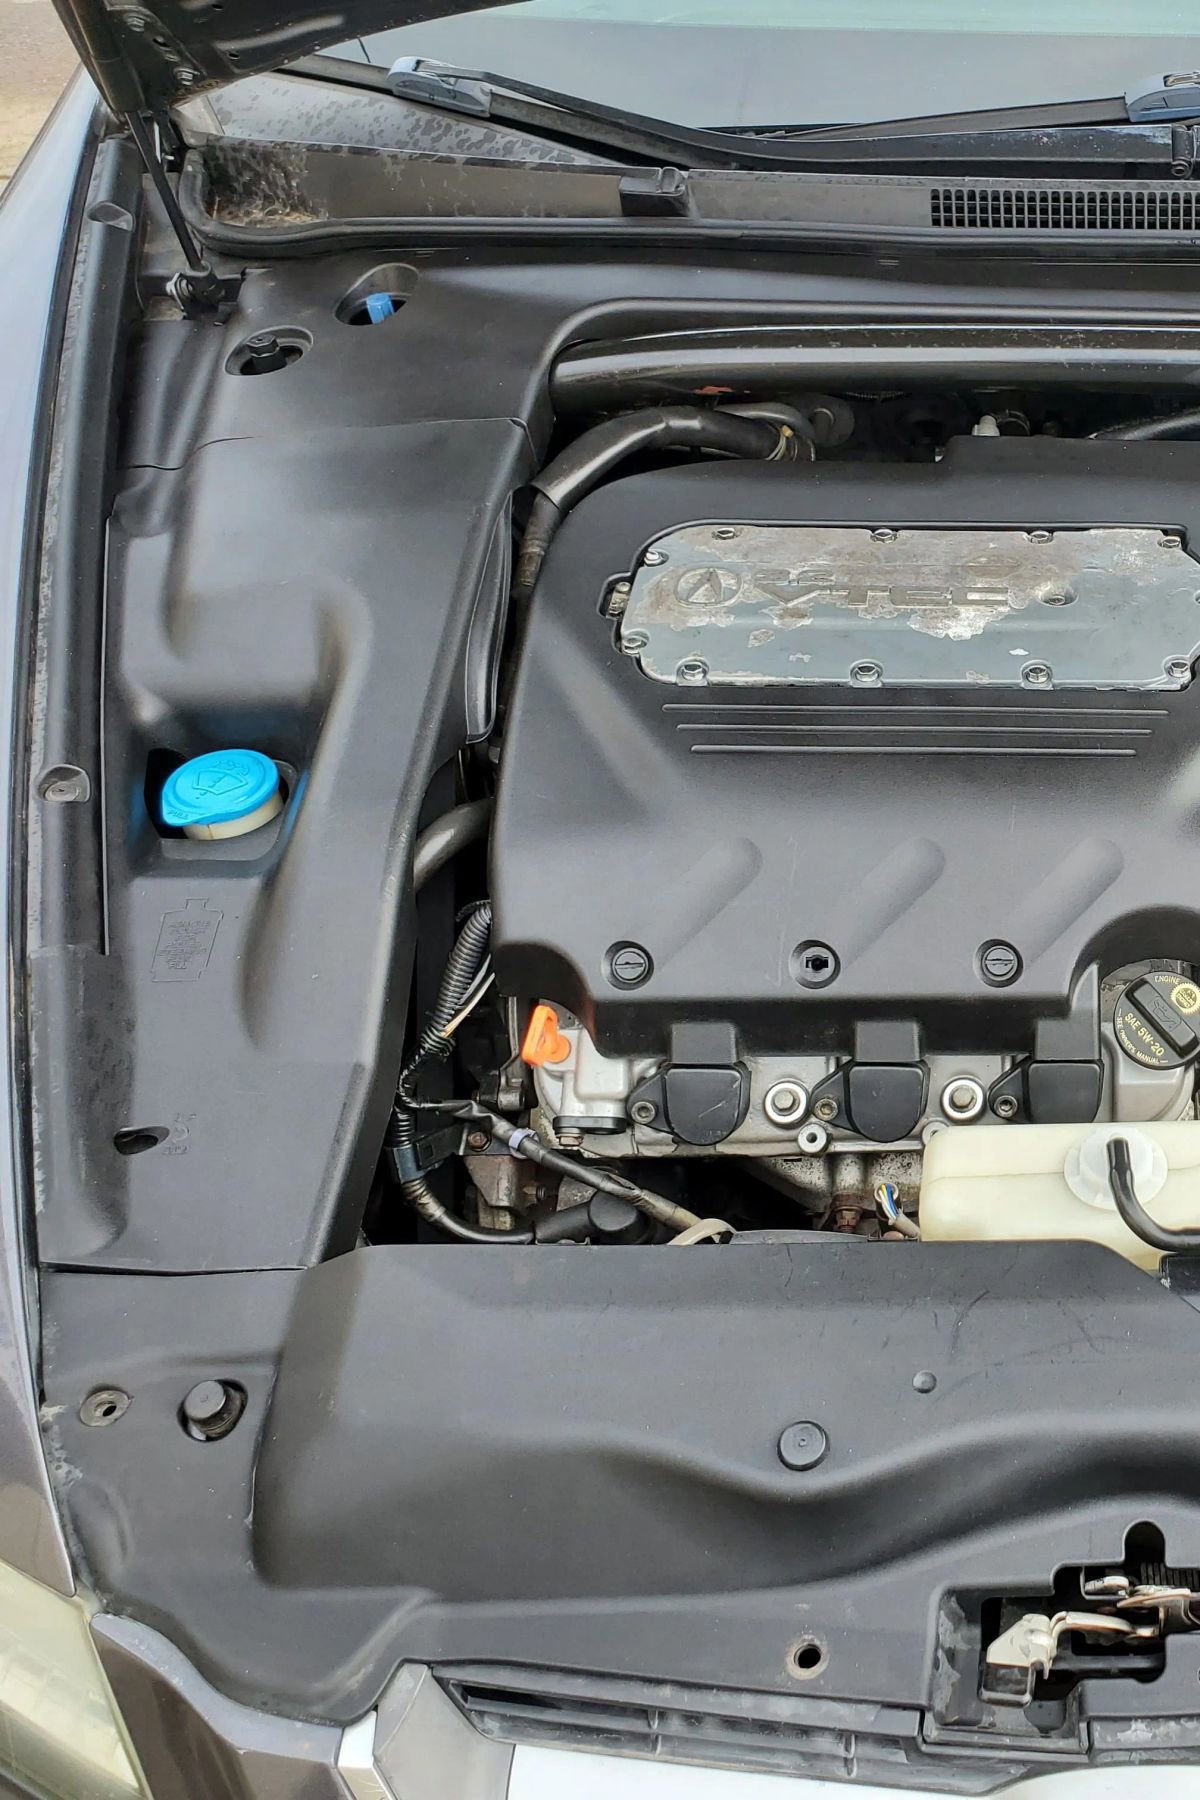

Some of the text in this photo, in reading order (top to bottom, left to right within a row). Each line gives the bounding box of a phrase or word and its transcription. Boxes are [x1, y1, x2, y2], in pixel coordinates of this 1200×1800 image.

[753, 584, 1010, 608] VTEC
[1154, 975, 1180, 984] ENGINE
[1124, 1012, 1141, 1030] SAE
[1136, 1051, 1160, 1065] MANUAL
